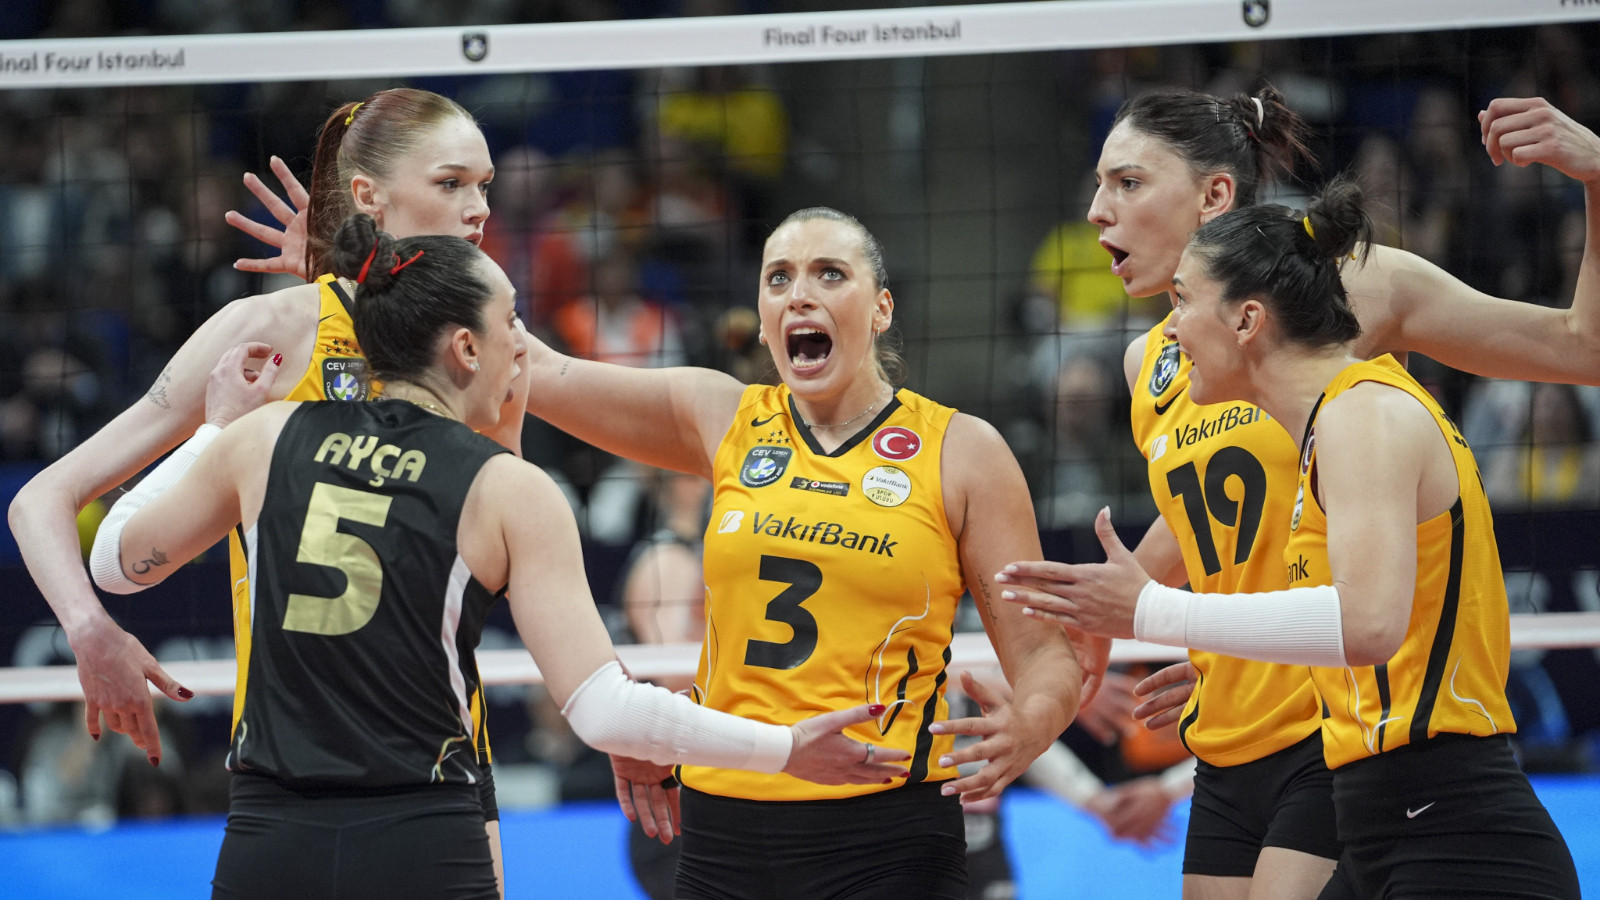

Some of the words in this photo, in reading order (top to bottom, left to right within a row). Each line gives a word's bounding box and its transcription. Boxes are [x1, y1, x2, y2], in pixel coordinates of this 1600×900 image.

[764, 26, 815, 46] Final
[821, 24, 868, 44] Four
[873, 18, 961, 41] Istanbul
[0, 51, 38, 72] inal
[44, 51, 92, 71] Four
[98, 47, 185, 69] Istanbul
[326, 361, 346, 371] CEV
[1175, 405, 1271, 450] VakıfBan
[313, 432, 427, 488] AYÇA
[752, 449, 772, 457] CEV
[1166, 446, 1267, 577] 19
[753, 512, 898, 558] VakıfBank
[282, 481, 394, 636] 5
[1288, 554, 1309, 584] ank
[744, 554, 823, 670] 3
